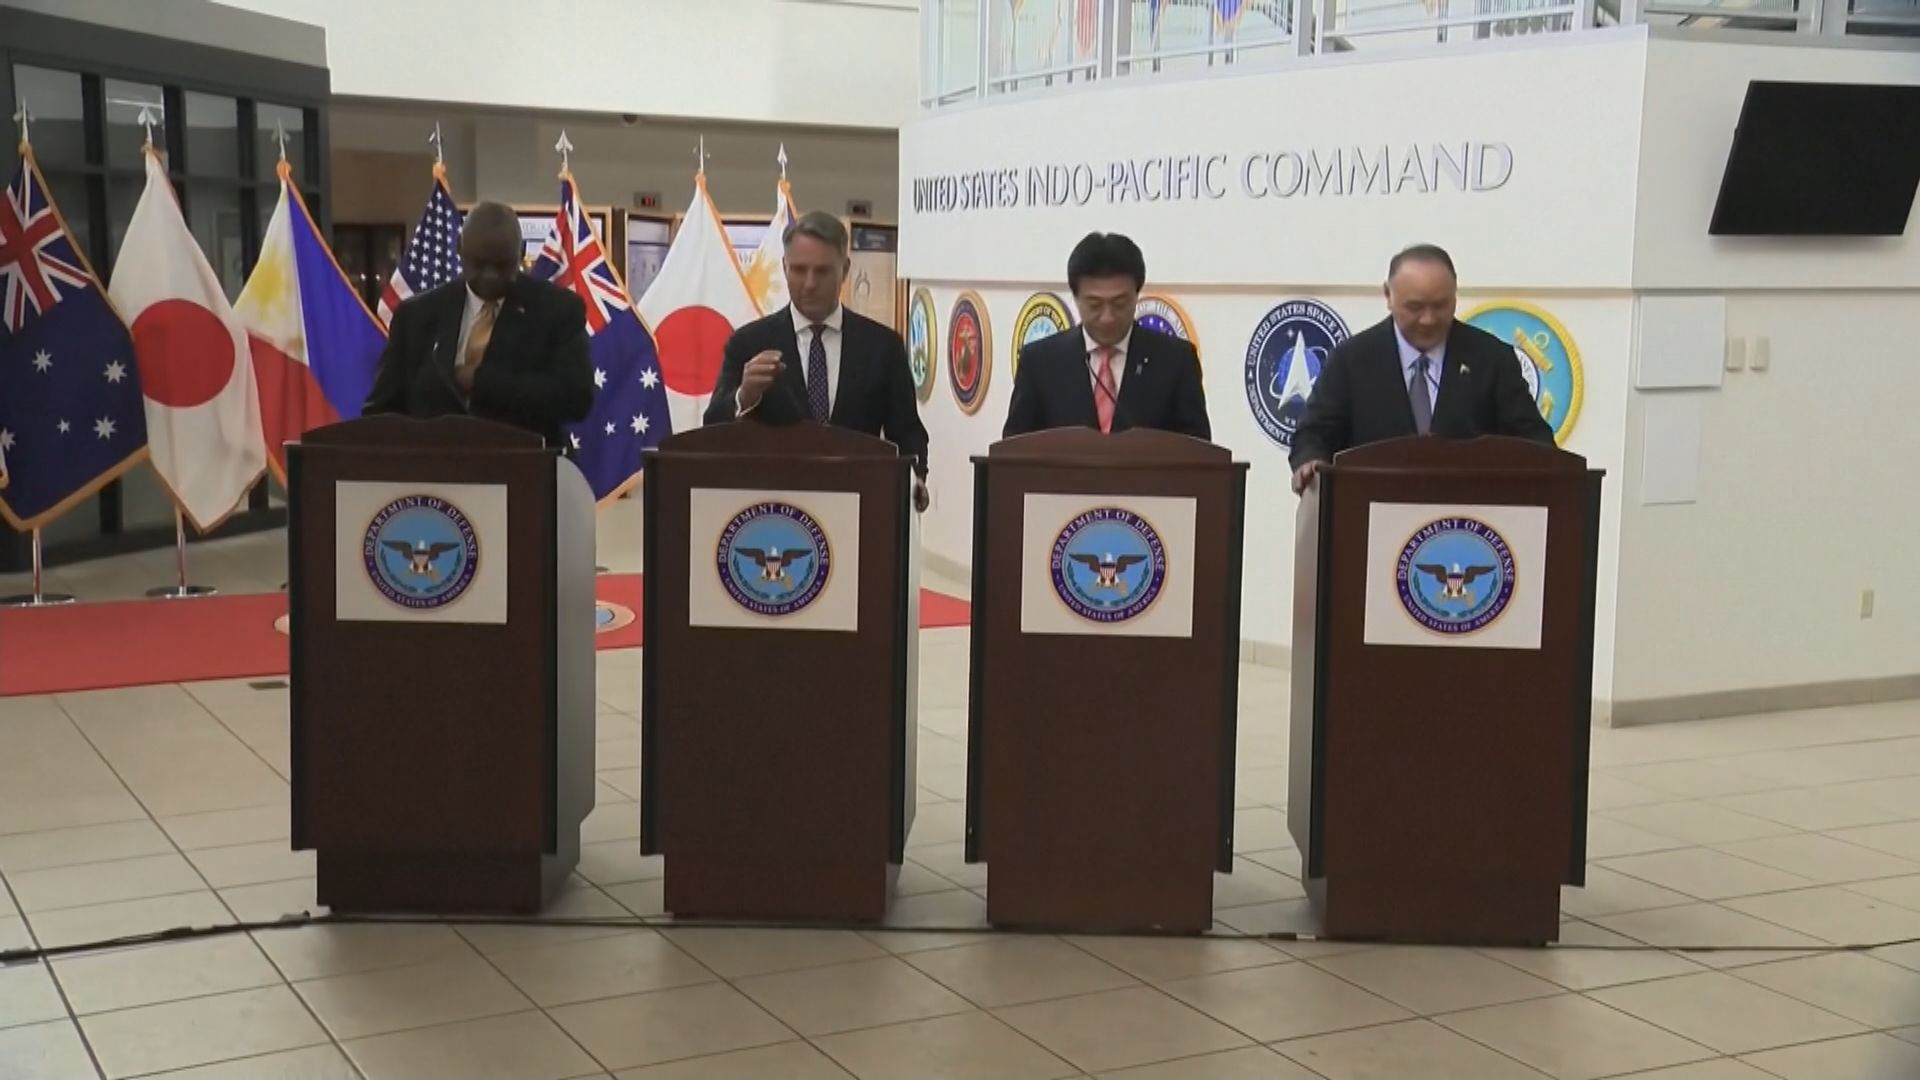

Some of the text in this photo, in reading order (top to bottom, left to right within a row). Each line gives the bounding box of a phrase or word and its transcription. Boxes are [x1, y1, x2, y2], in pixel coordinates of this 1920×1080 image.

[912, 141, 1514, 214] UNITED STATES INDO-PACIFIC COMMAND
[1247, 303, 1336, 366] UNITED STATES SPACE
[365, 496, 478, 560] DEPARTMENT OF DEFENSE
[718, 503, 830, 566] DEPARTMENT OF DEFENSE
[1052, 509, 1165, 571] DEPARTMENT OF DEFENSE
[1397, 518, 1515, 582] DEPARTMENT OF DEFENSE
[1428, 619, 1459, 633] STATES
